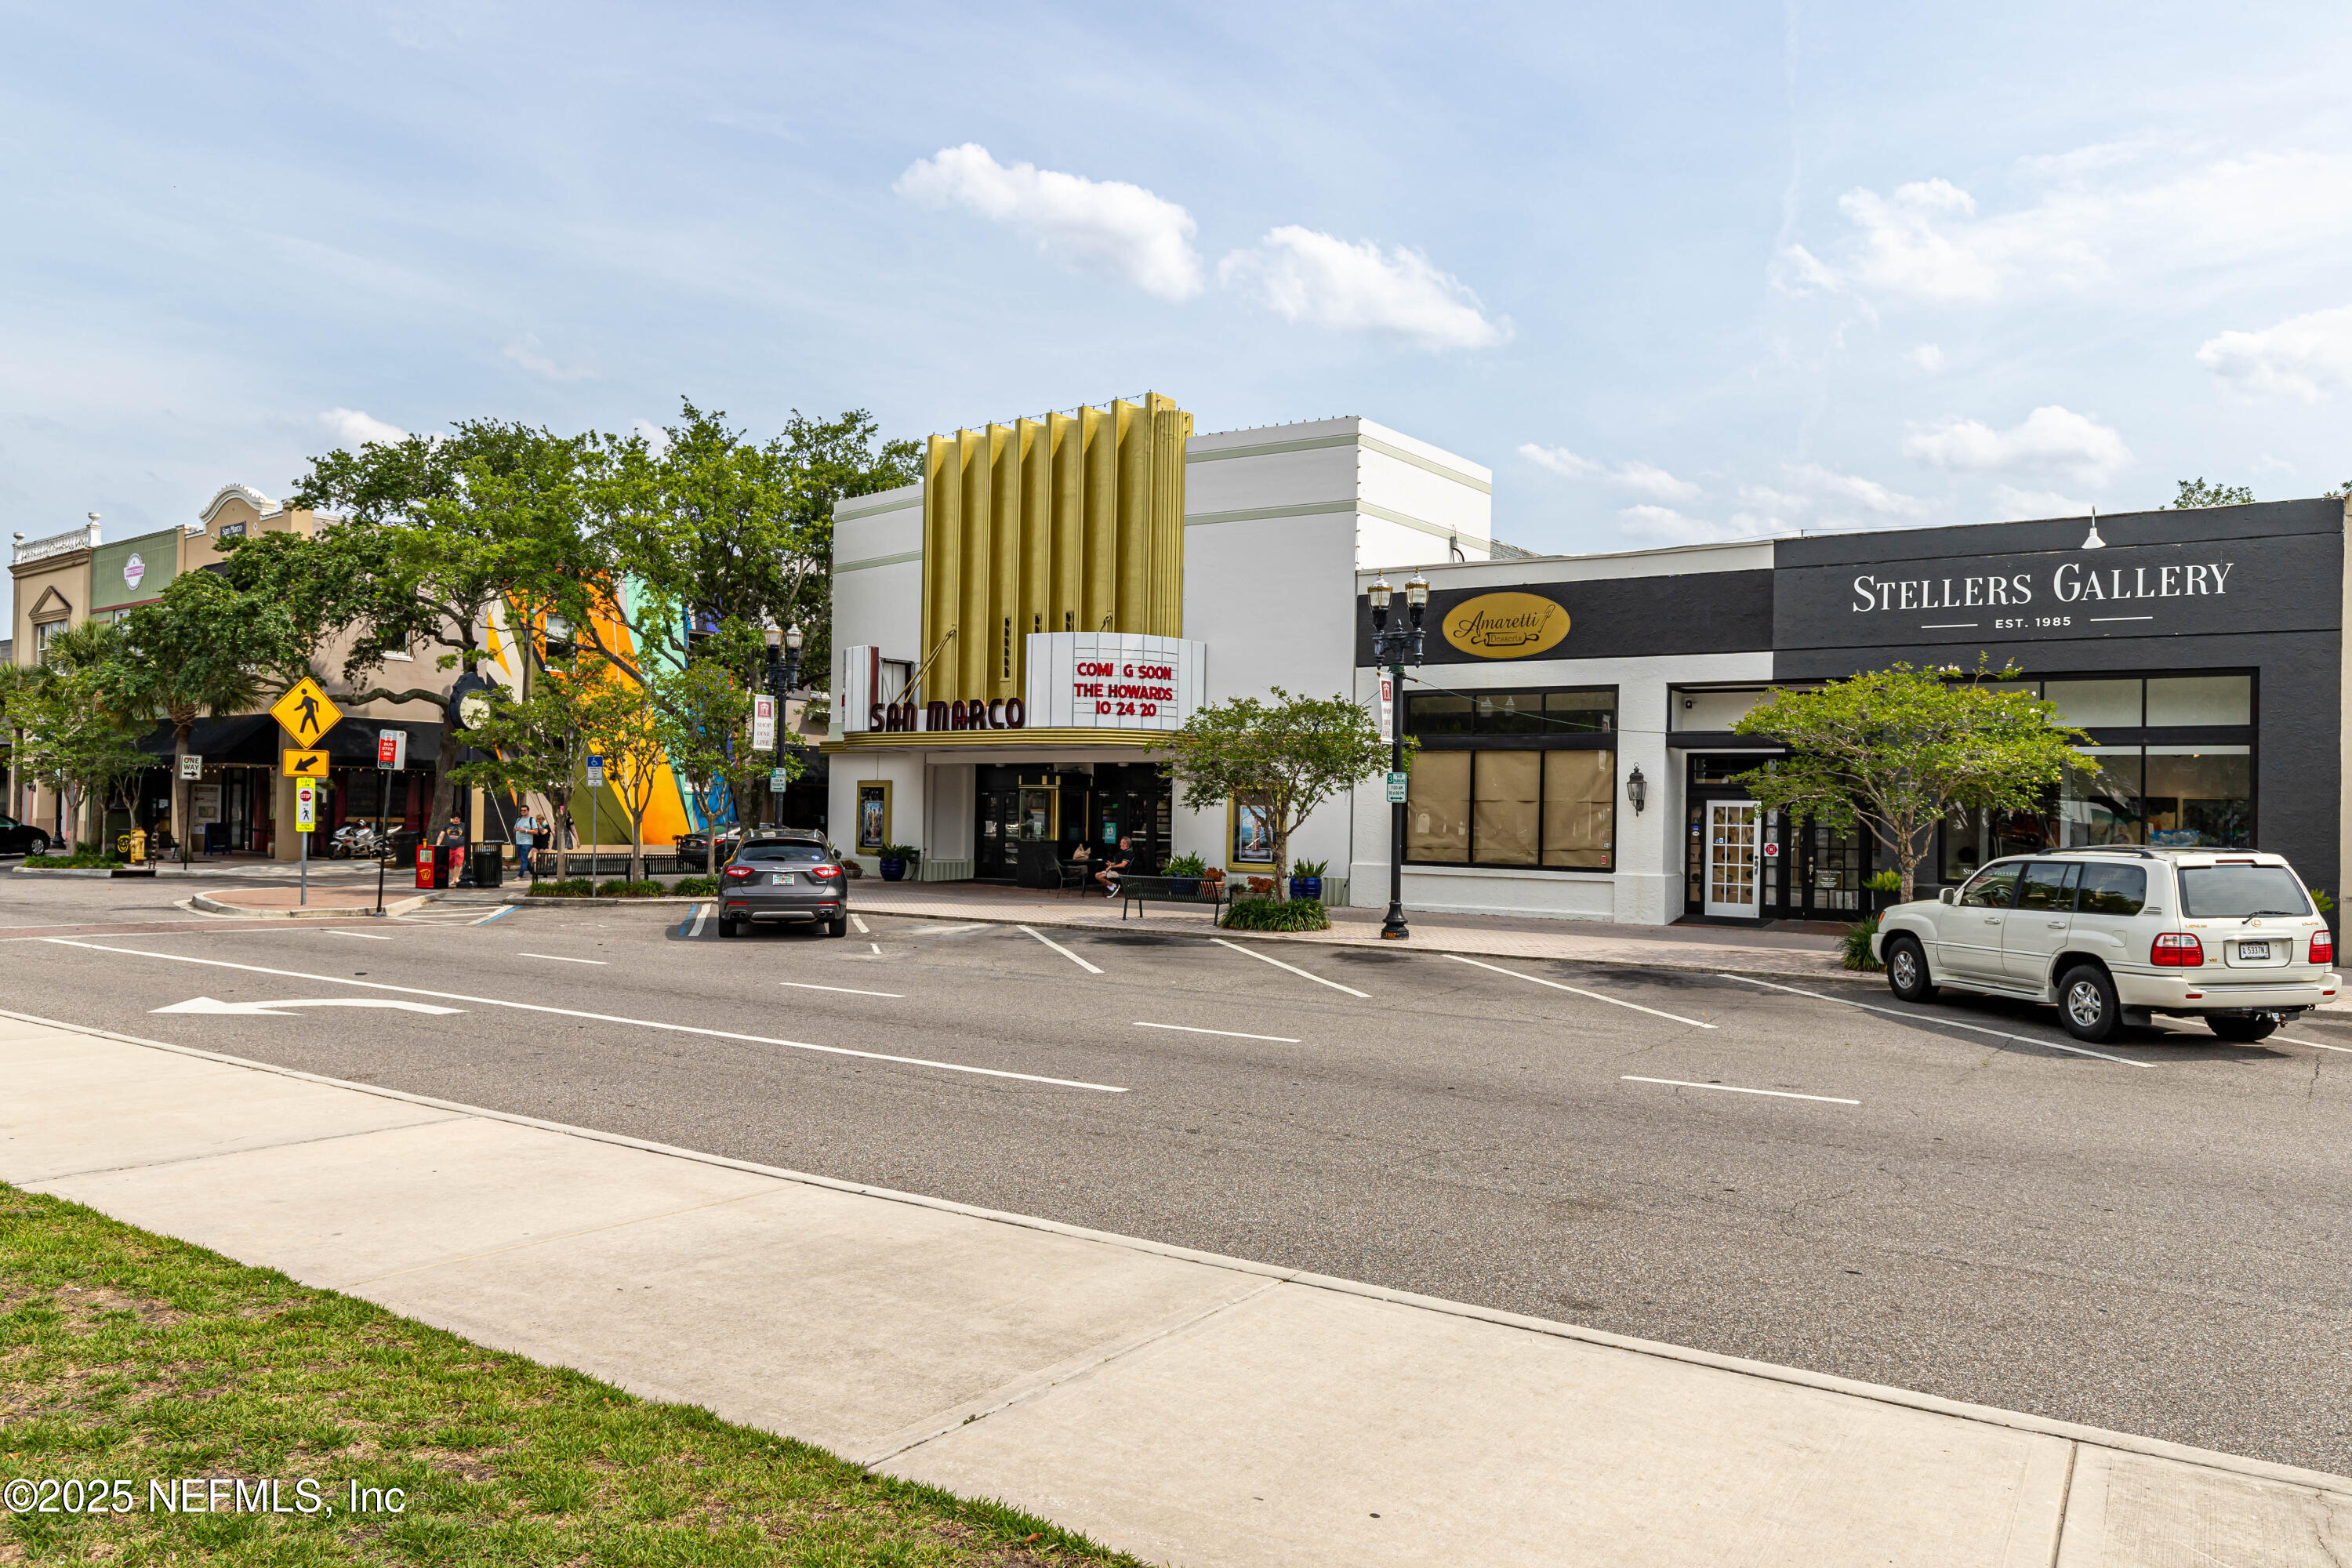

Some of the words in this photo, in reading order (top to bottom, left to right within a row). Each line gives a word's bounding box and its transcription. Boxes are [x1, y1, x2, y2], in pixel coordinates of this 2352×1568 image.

[1853, 575, 2032, 612] STELLERS
[2053, 563, 2234, 602] GALLERY
[1453, 610, 1540, 638] Amaretti
[1995, 619, 2028, 629] EST.
[2035, 616, 2071, 627] 1985
[1490, 634, 1523, 643] Desserts
[1138, 665, 1172, 681] SOON
[1074, 683, 1104, 697] THE
[1108, 684, 1173, 701] HOWARDS
[869, 702, 918, 732] SAN
[926, 697, 1025, 731] MARCO
[1096, 700, 1112, 715] 10
[1116, 702, 1135, 716] 24
[1140, 702, 1157, 717] 20
